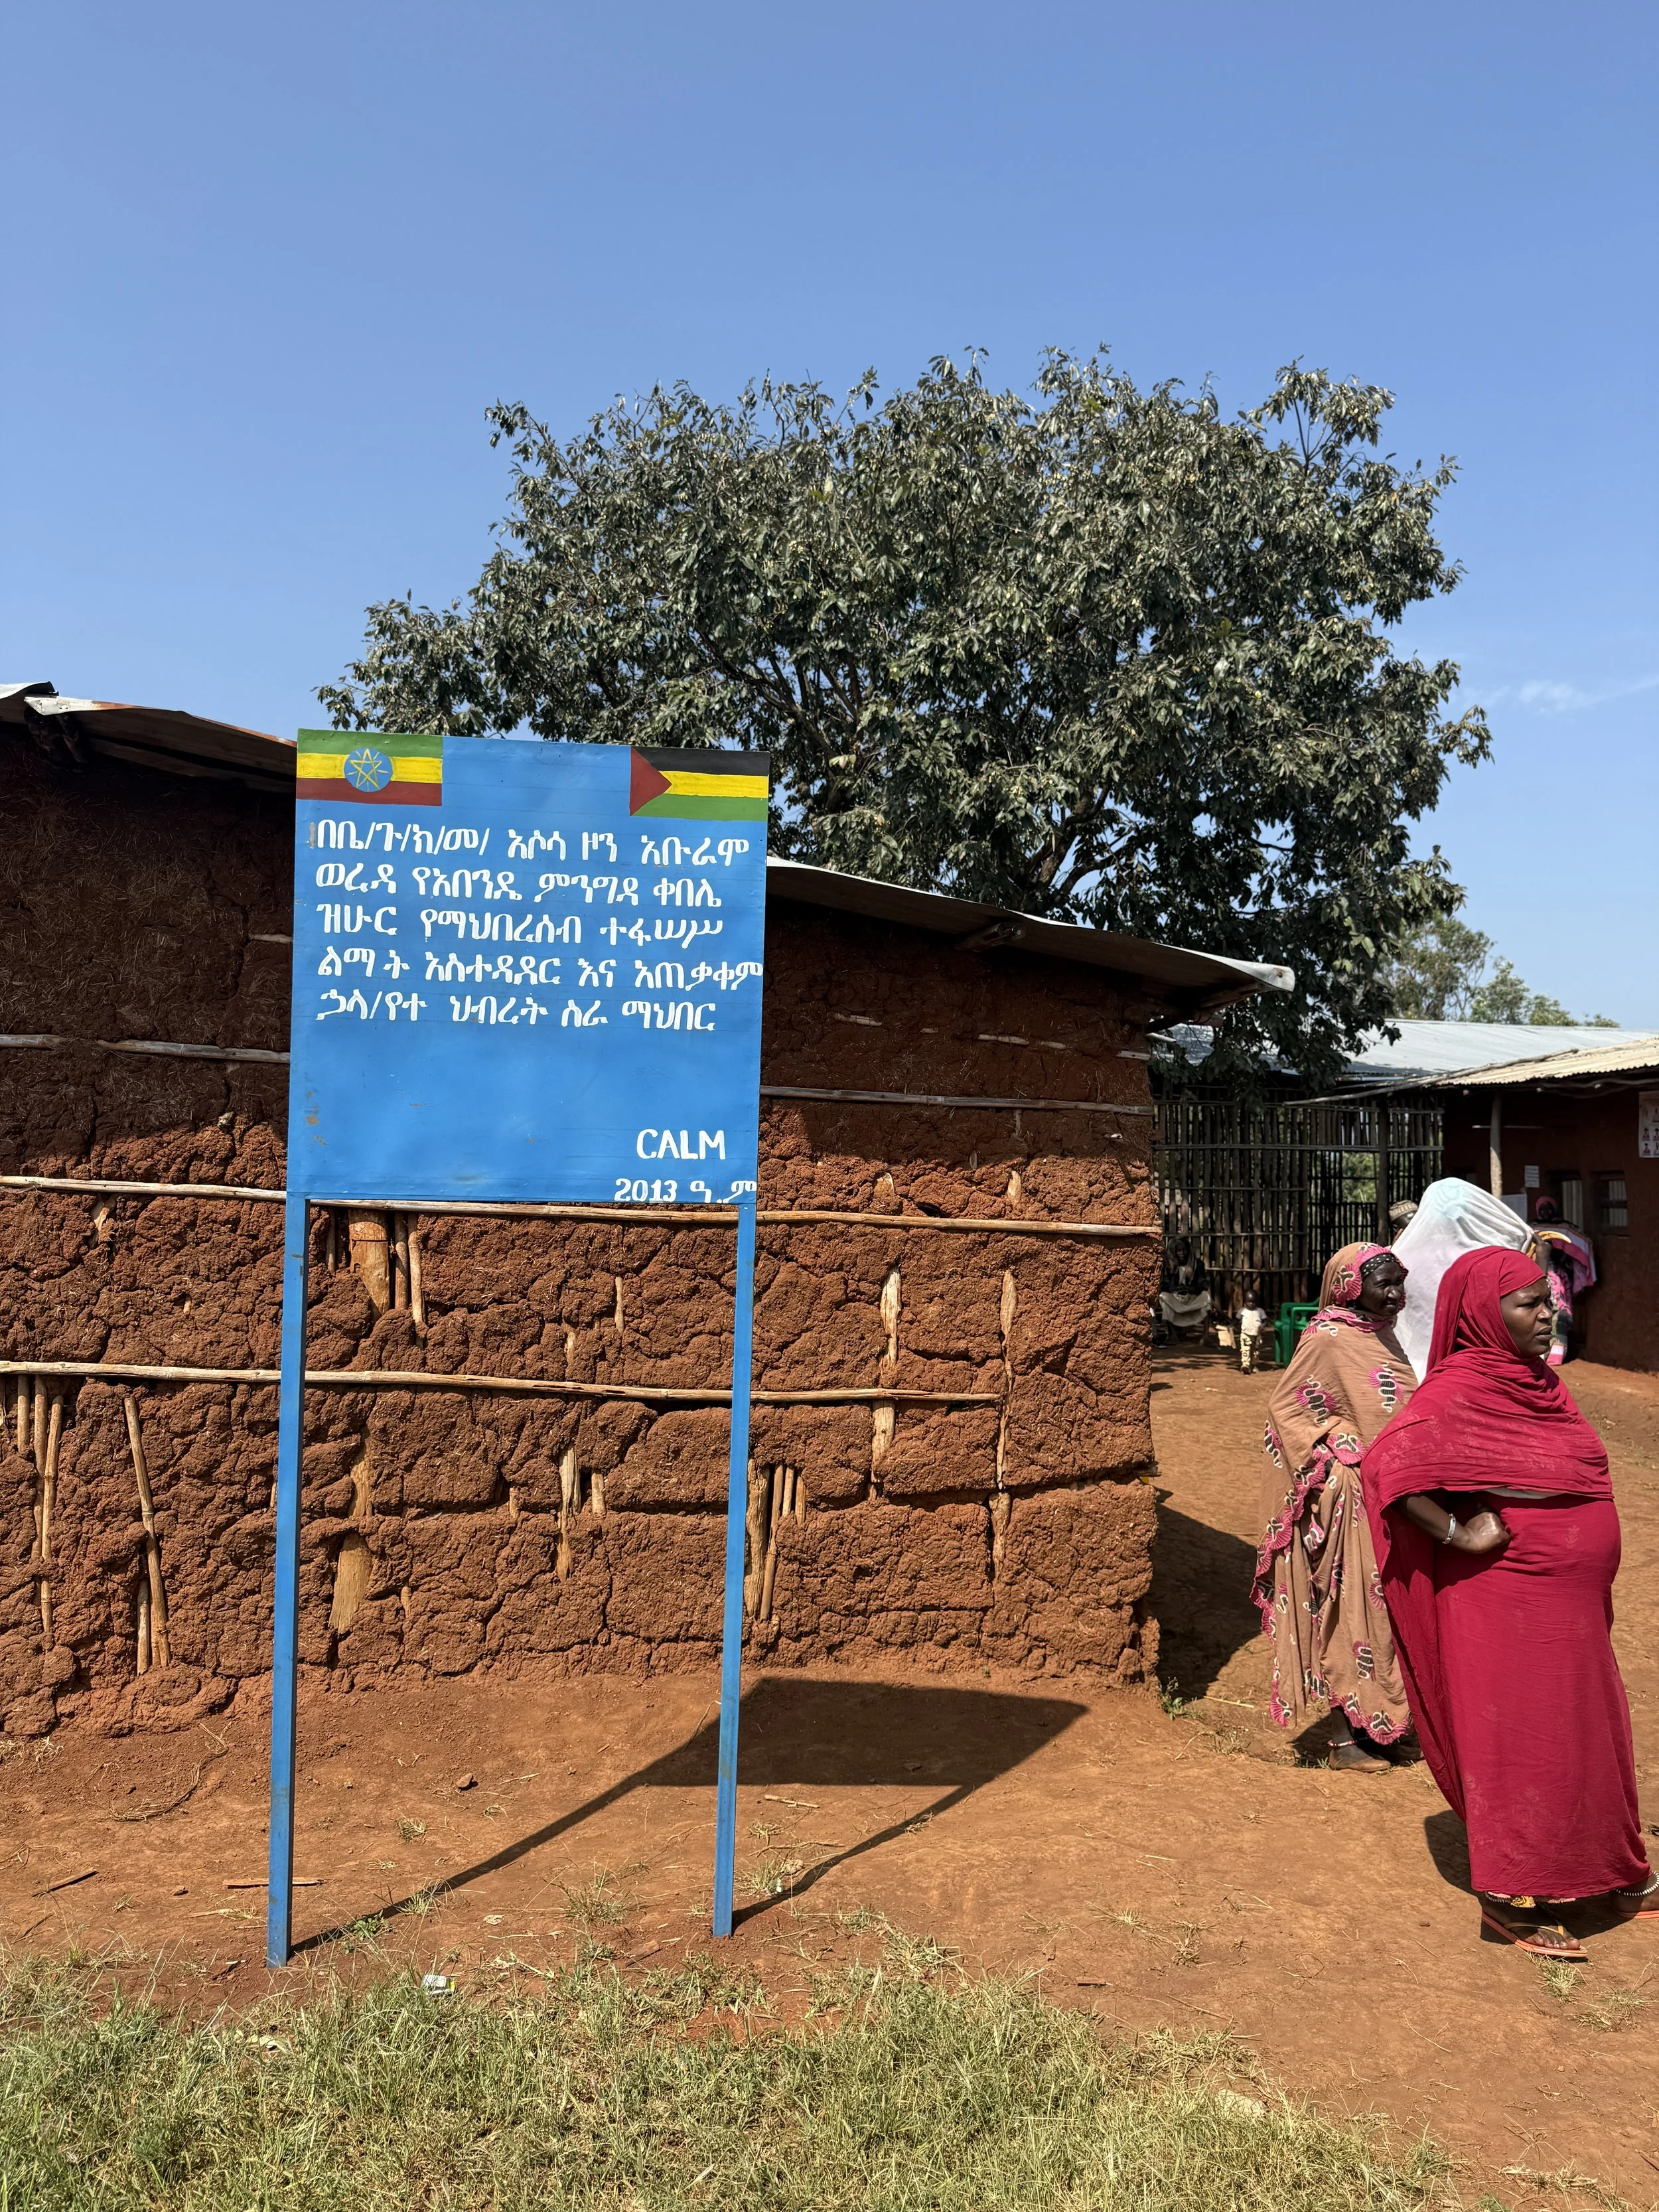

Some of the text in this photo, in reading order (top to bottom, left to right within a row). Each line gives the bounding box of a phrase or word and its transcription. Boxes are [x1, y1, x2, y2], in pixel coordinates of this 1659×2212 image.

[508, 829, 566, 861] አሶሳ
[582, 832, 618, 862] ዞን
[641, 835, 749, 867] አቡራሞ
[315, 862, 397, 894] ወረዳ
[411, 867, 523, 901] የአበንዴ
[653, 877, 722, 907] ቀበሌ
[316, 903, 397, 936] ዝሁር
[420, 909, 582, 944] የማህበረሰብ
[425, 951, 561, 986] አስተዳደር
[577, 958, 617, 988] እና
[634, 960, 764, 991] አጠቃቀም
[315, 988, 716, 1031] ኃላ/የተ ህብረት ስራ ማህበር
[636, 1128, 726, 1160] CALM
[614, 1178, 678, 1203] 2013
